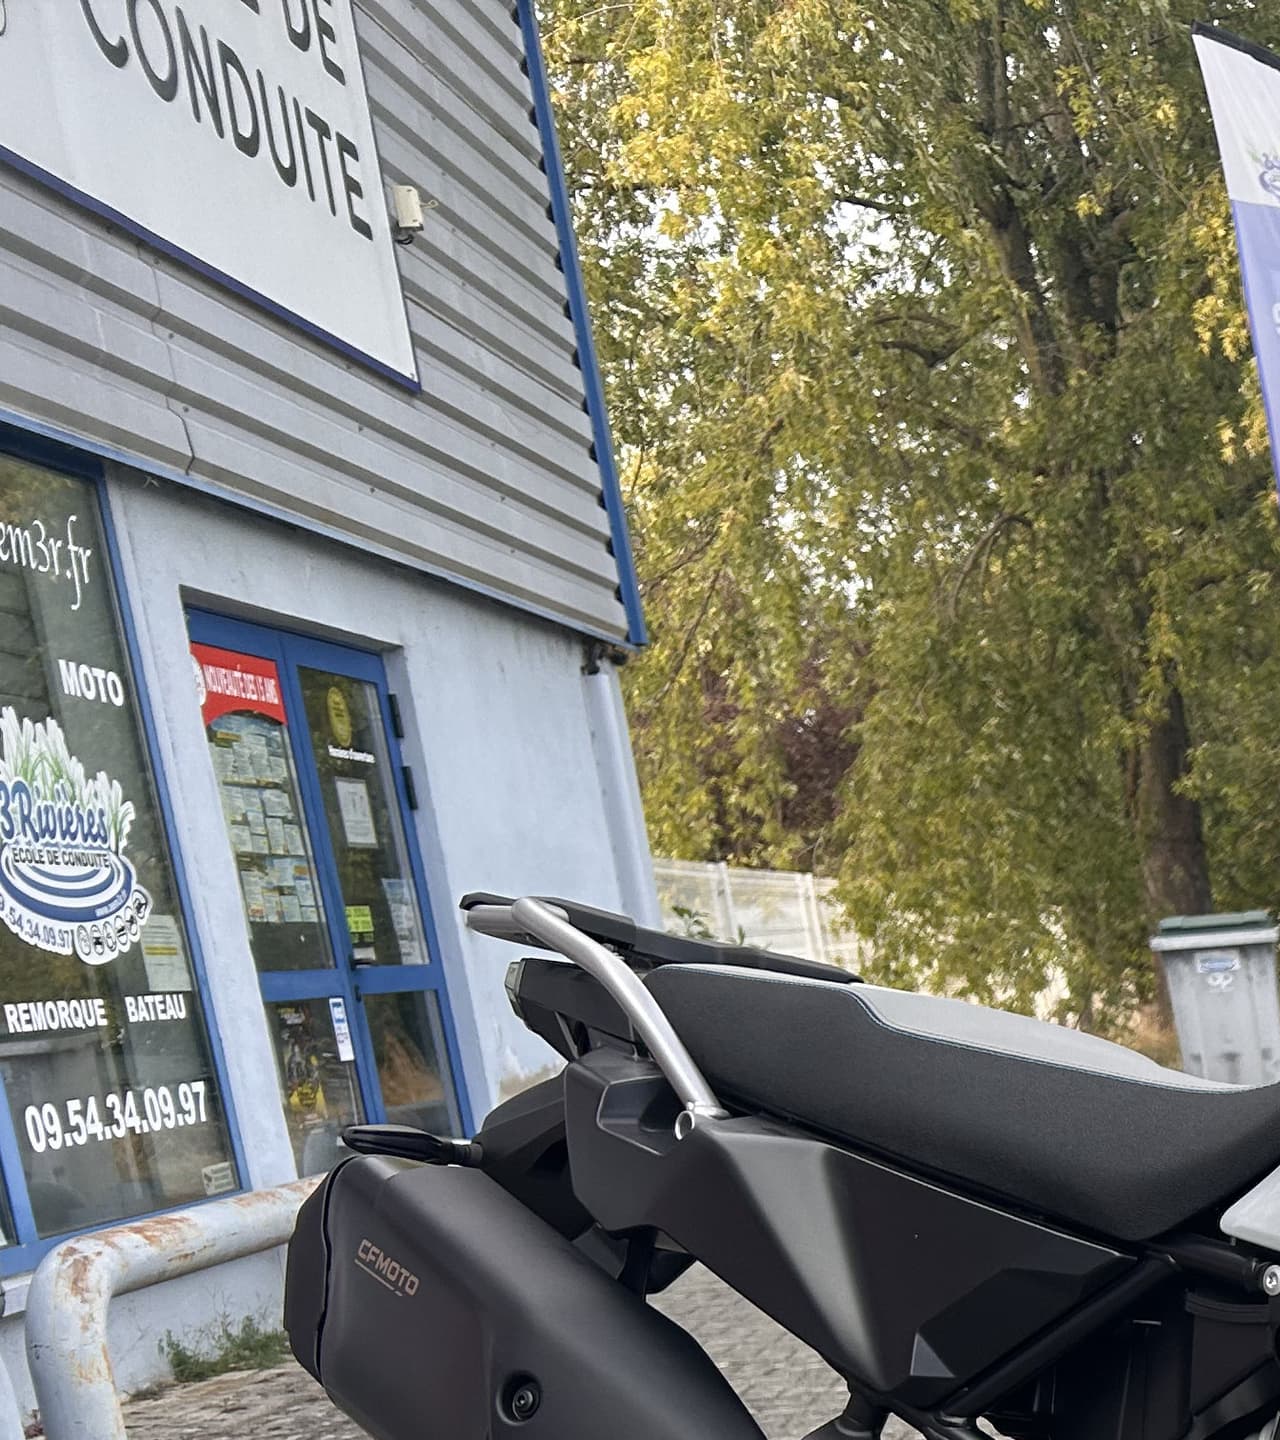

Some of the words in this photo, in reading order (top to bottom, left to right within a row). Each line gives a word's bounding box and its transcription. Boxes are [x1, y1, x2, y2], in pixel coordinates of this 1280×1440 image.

[80, 0, 373, 241] CONDUITE
[58, 659, 124, 707] MOTO
[4, 999, 108, 1033] REMORQUE
[125, 994, 187, 1022] BATEAU
[25, 1081, 207, 1152] 09.54.34.09.97
[356, 1238, 420, 1296] CFMOTO
